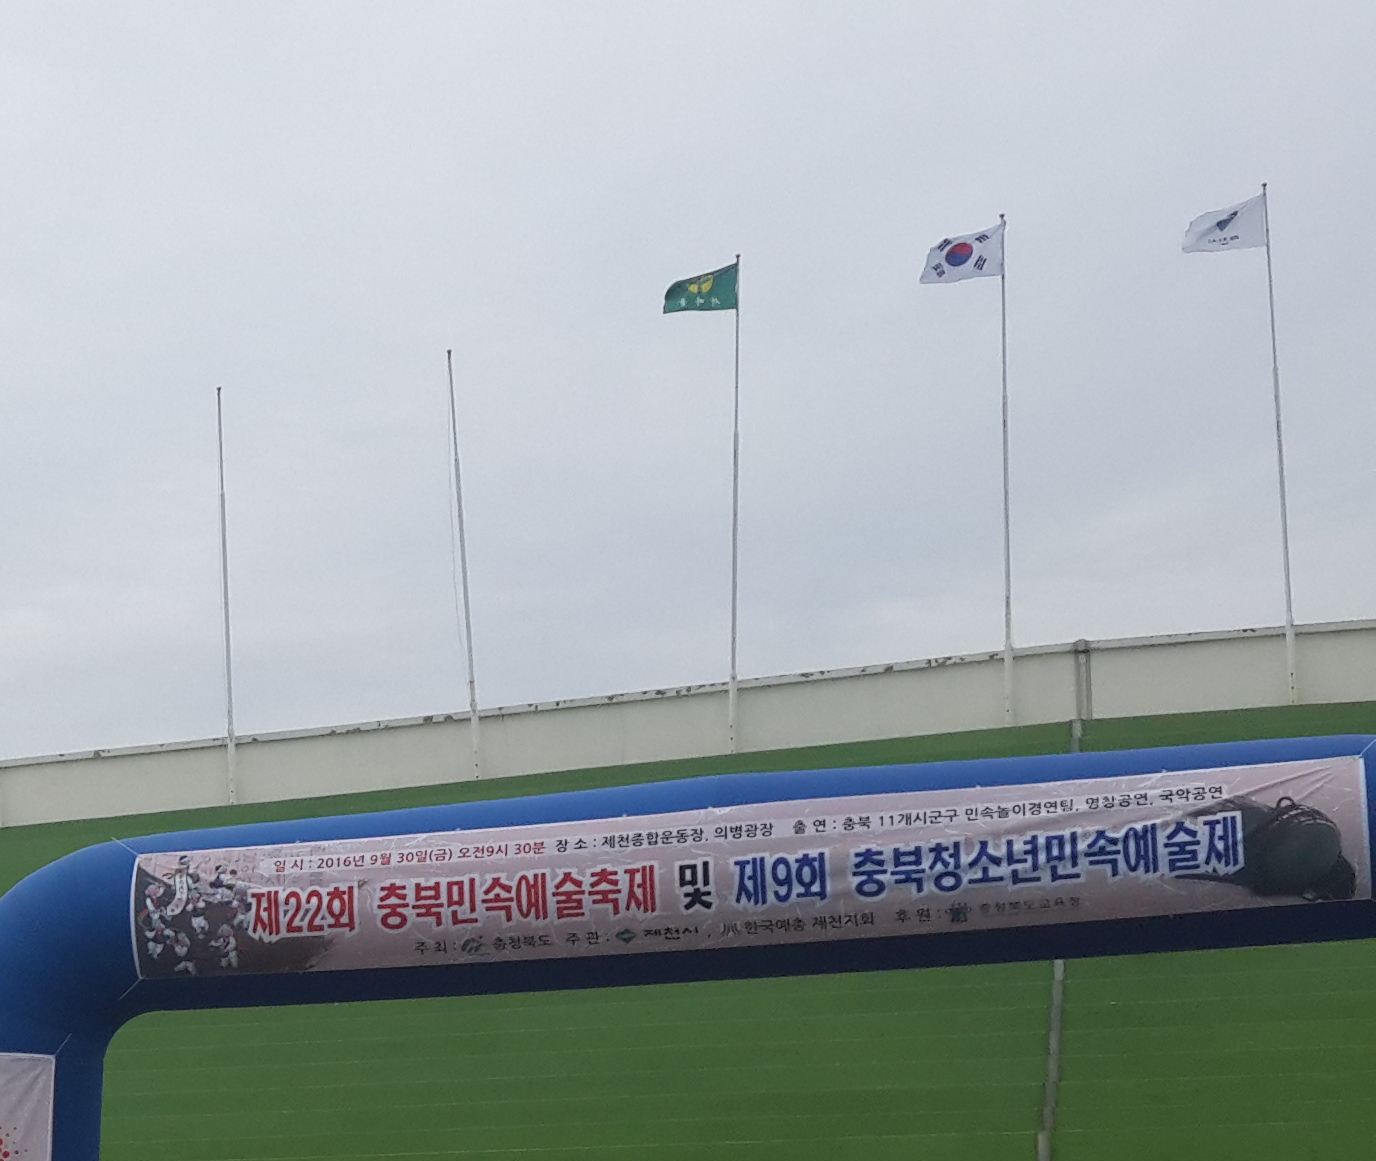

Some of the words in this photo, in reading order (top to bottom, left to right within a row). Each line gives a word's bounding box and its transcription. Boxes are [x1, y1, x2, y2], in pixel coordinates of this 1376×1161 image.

[316, 855, 366, 871] 2016년
[369, 850, 392, 867] 9월
[396, 846, 453, 865] 30일(금)
[457, 842, 510, 861] 오전9시
[514, 841, 547, 857] 30분
[714, 821, 774, 842] 의병광장
[843, 815, 872, 831] 충북
[878, 808, 960, 828] 11개시군구
[1159, 785, 1224, 804] 국악공연
[251, 884, 356, 936] 제22회
[377, 864, 658, 930] 충북민속예술축제
[678, 860, 714, 911] 및
[733, 850, 829, 907] 제9회
[851, 815, 1240, 898] 충북청소년민속예술제
[644, 925, 700, 941] 제천시
